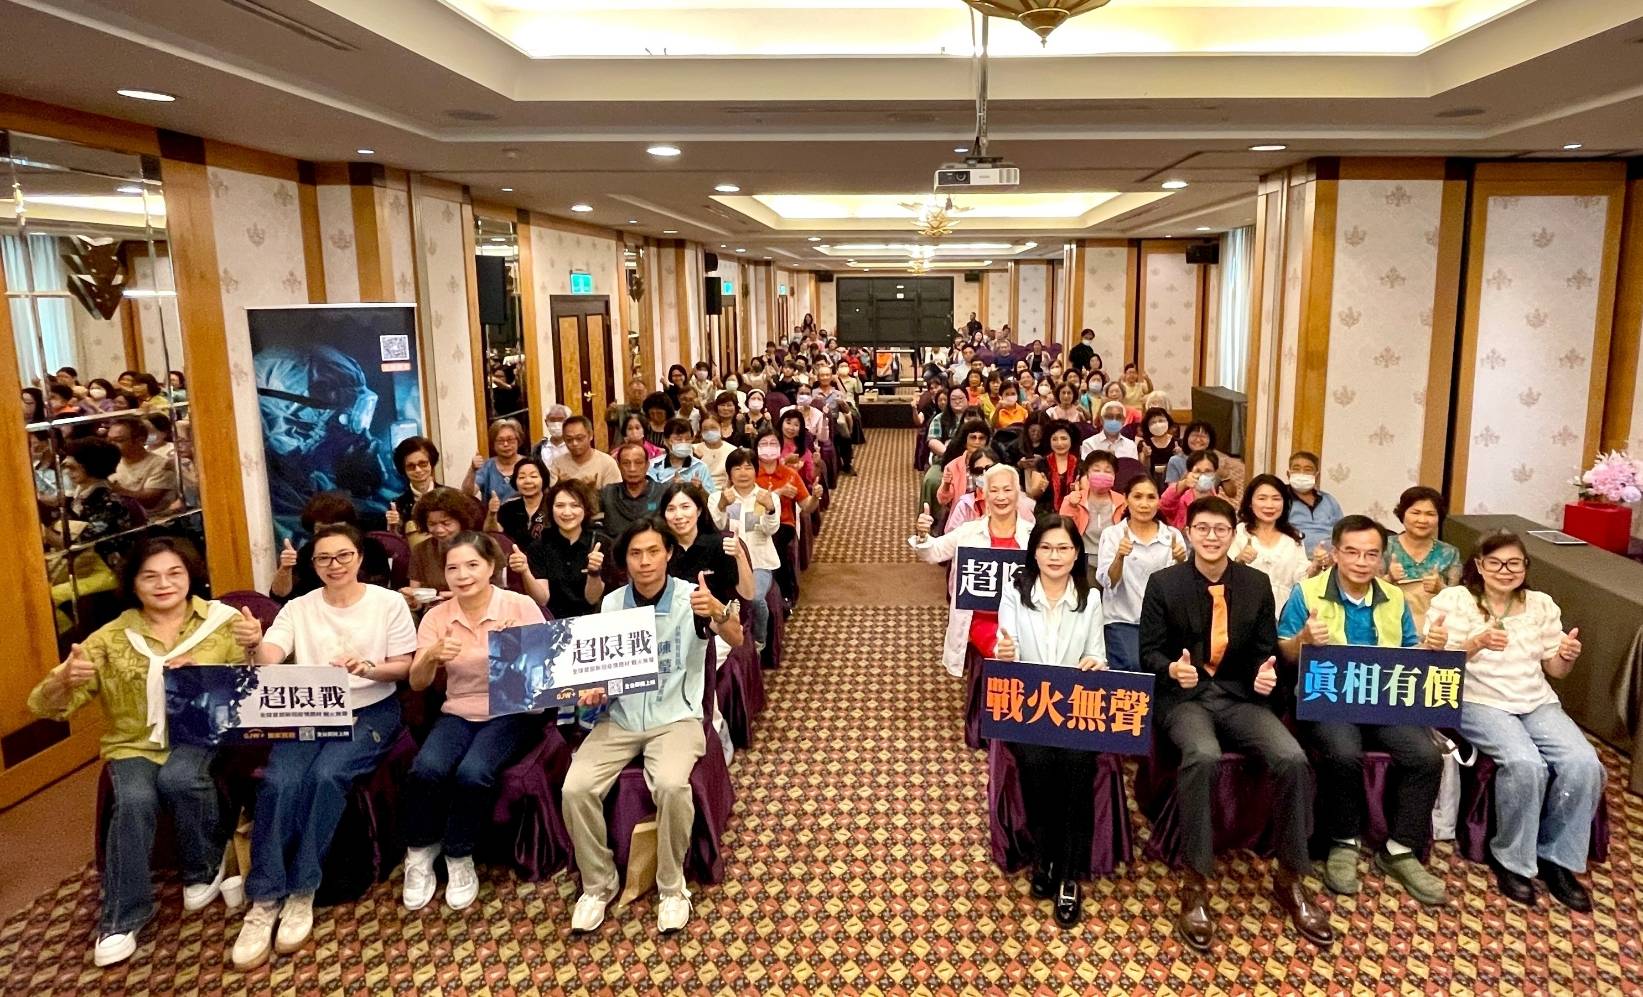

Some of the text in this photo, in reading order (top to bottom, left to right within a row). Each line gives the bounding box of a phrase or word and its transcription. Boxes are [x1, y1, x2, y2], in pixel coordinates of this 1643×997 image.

[572, 629, 653, 665] 超限戰
[259, 685, 346, 710] 超限戰
[985, 676, 1150, 737] 戰火無聲
